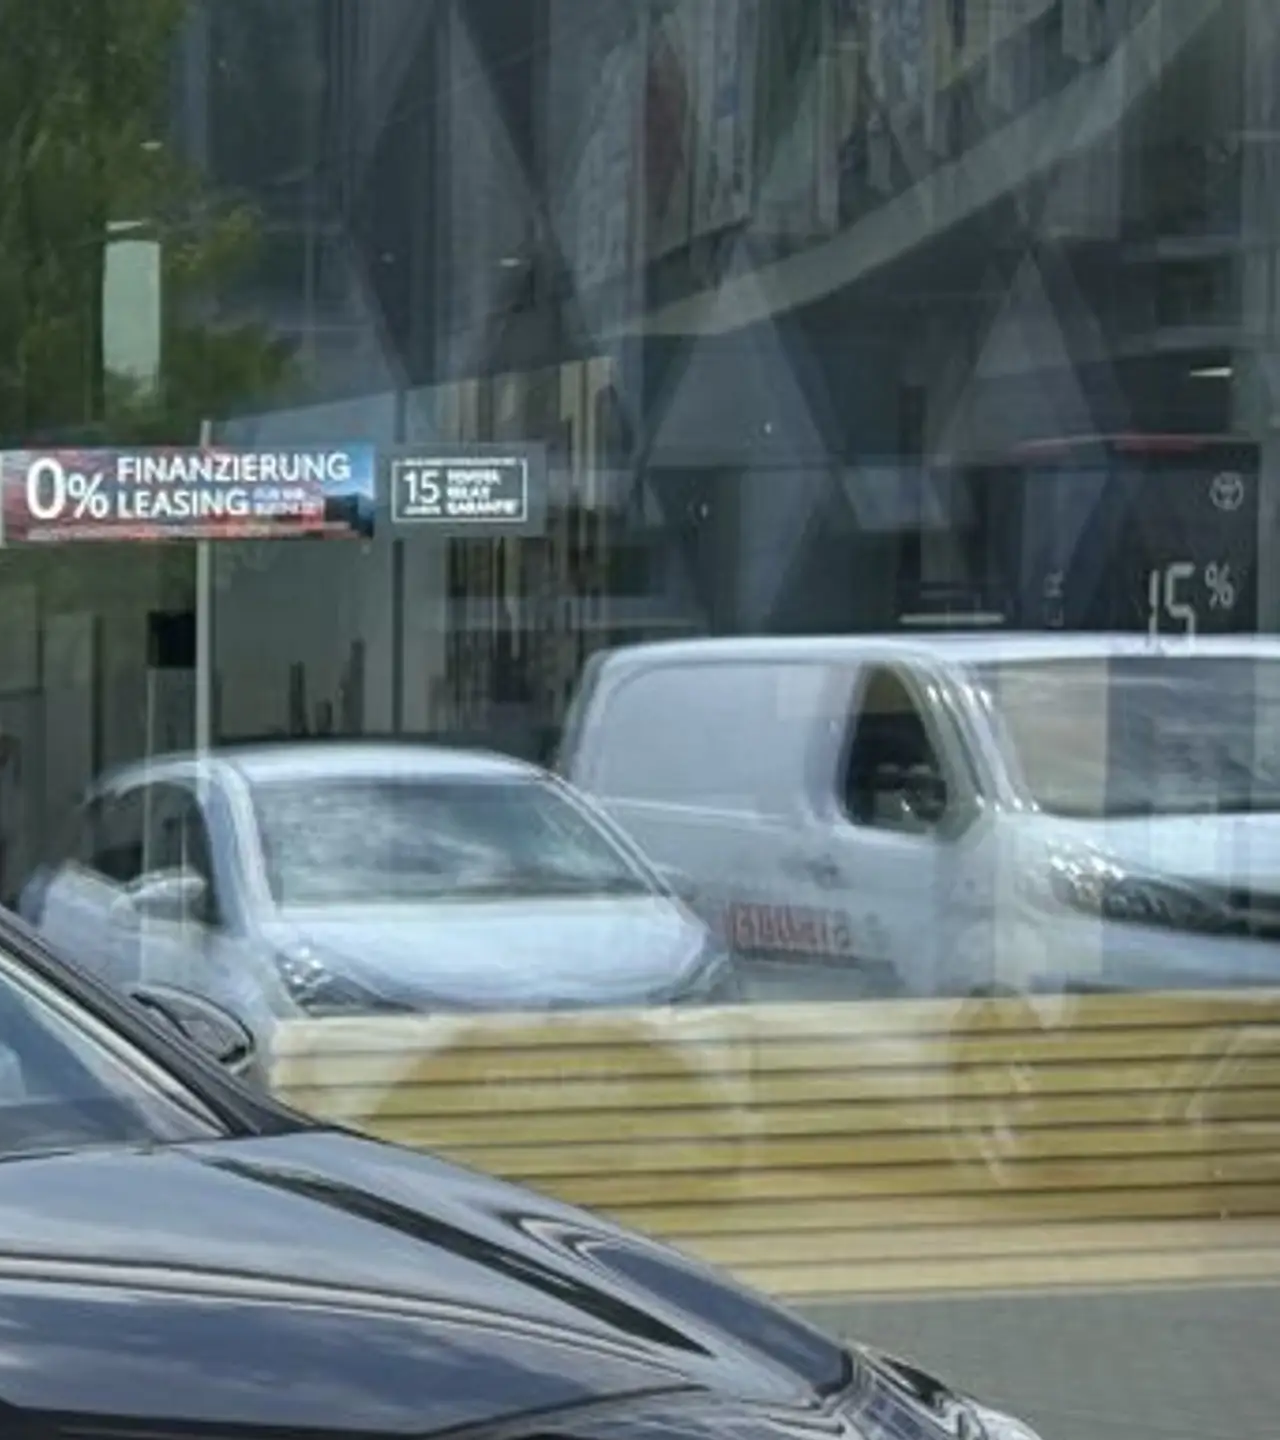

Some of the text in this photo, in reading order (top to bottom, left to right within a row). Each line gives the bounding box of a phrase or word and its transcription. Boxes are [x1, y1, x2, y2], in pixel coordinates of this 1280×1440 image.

[116, 452, 352, 483] FINANZIERUNG
[25, 456, 111, 519] 0%
[402, 468, 441, 504] 15
[117, 489, 250, 519] LEASING
